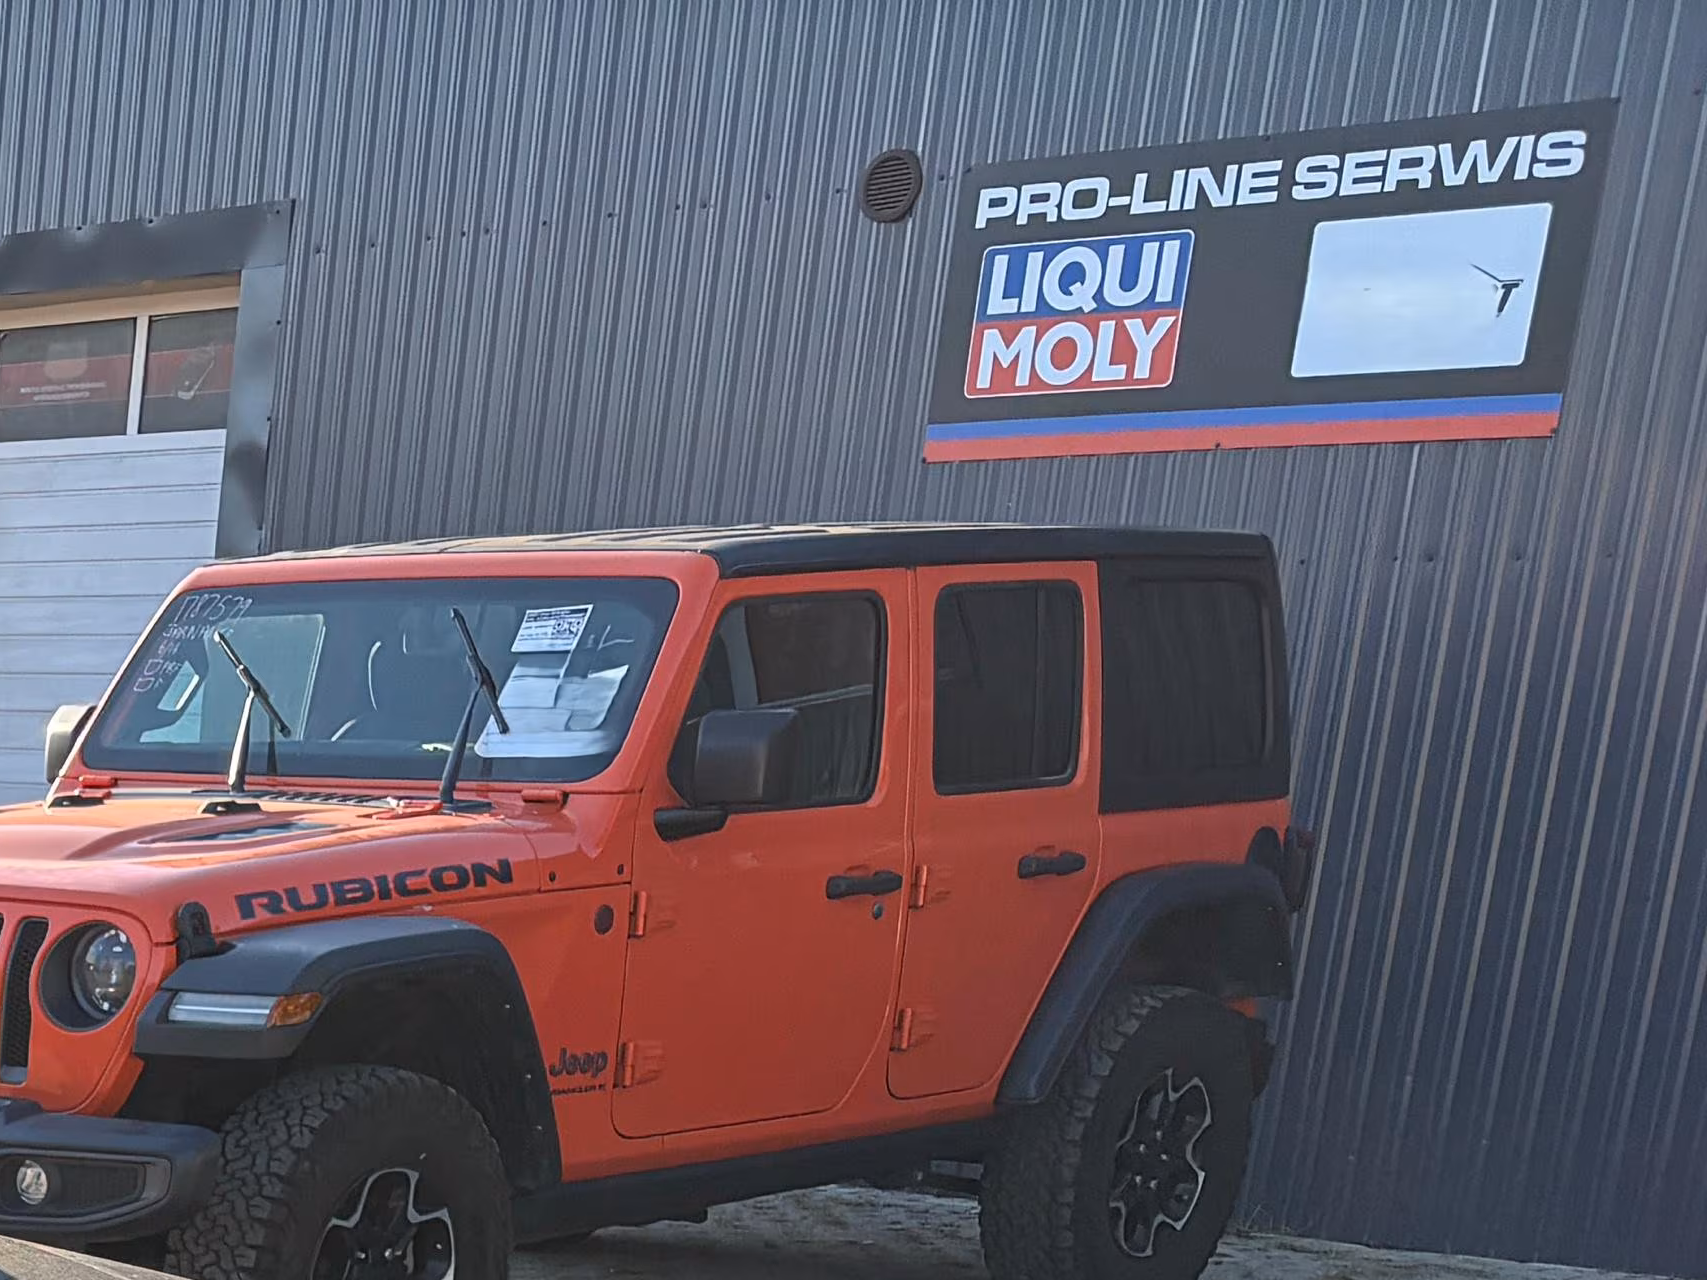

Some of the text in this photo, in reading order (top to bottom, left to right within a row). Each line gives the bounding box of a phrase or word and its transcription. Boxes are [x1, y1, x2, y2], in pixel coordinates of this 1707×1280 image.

[974, 129, 1588, 230] PRO-LINE SERWIS
[984, 239, 1183, 314] LIQUI
[976, 316, 1178, 390] MOLY
[235, 857, 514, 920] RUBICON
[548, 1047, 608, 1078] Jeep
